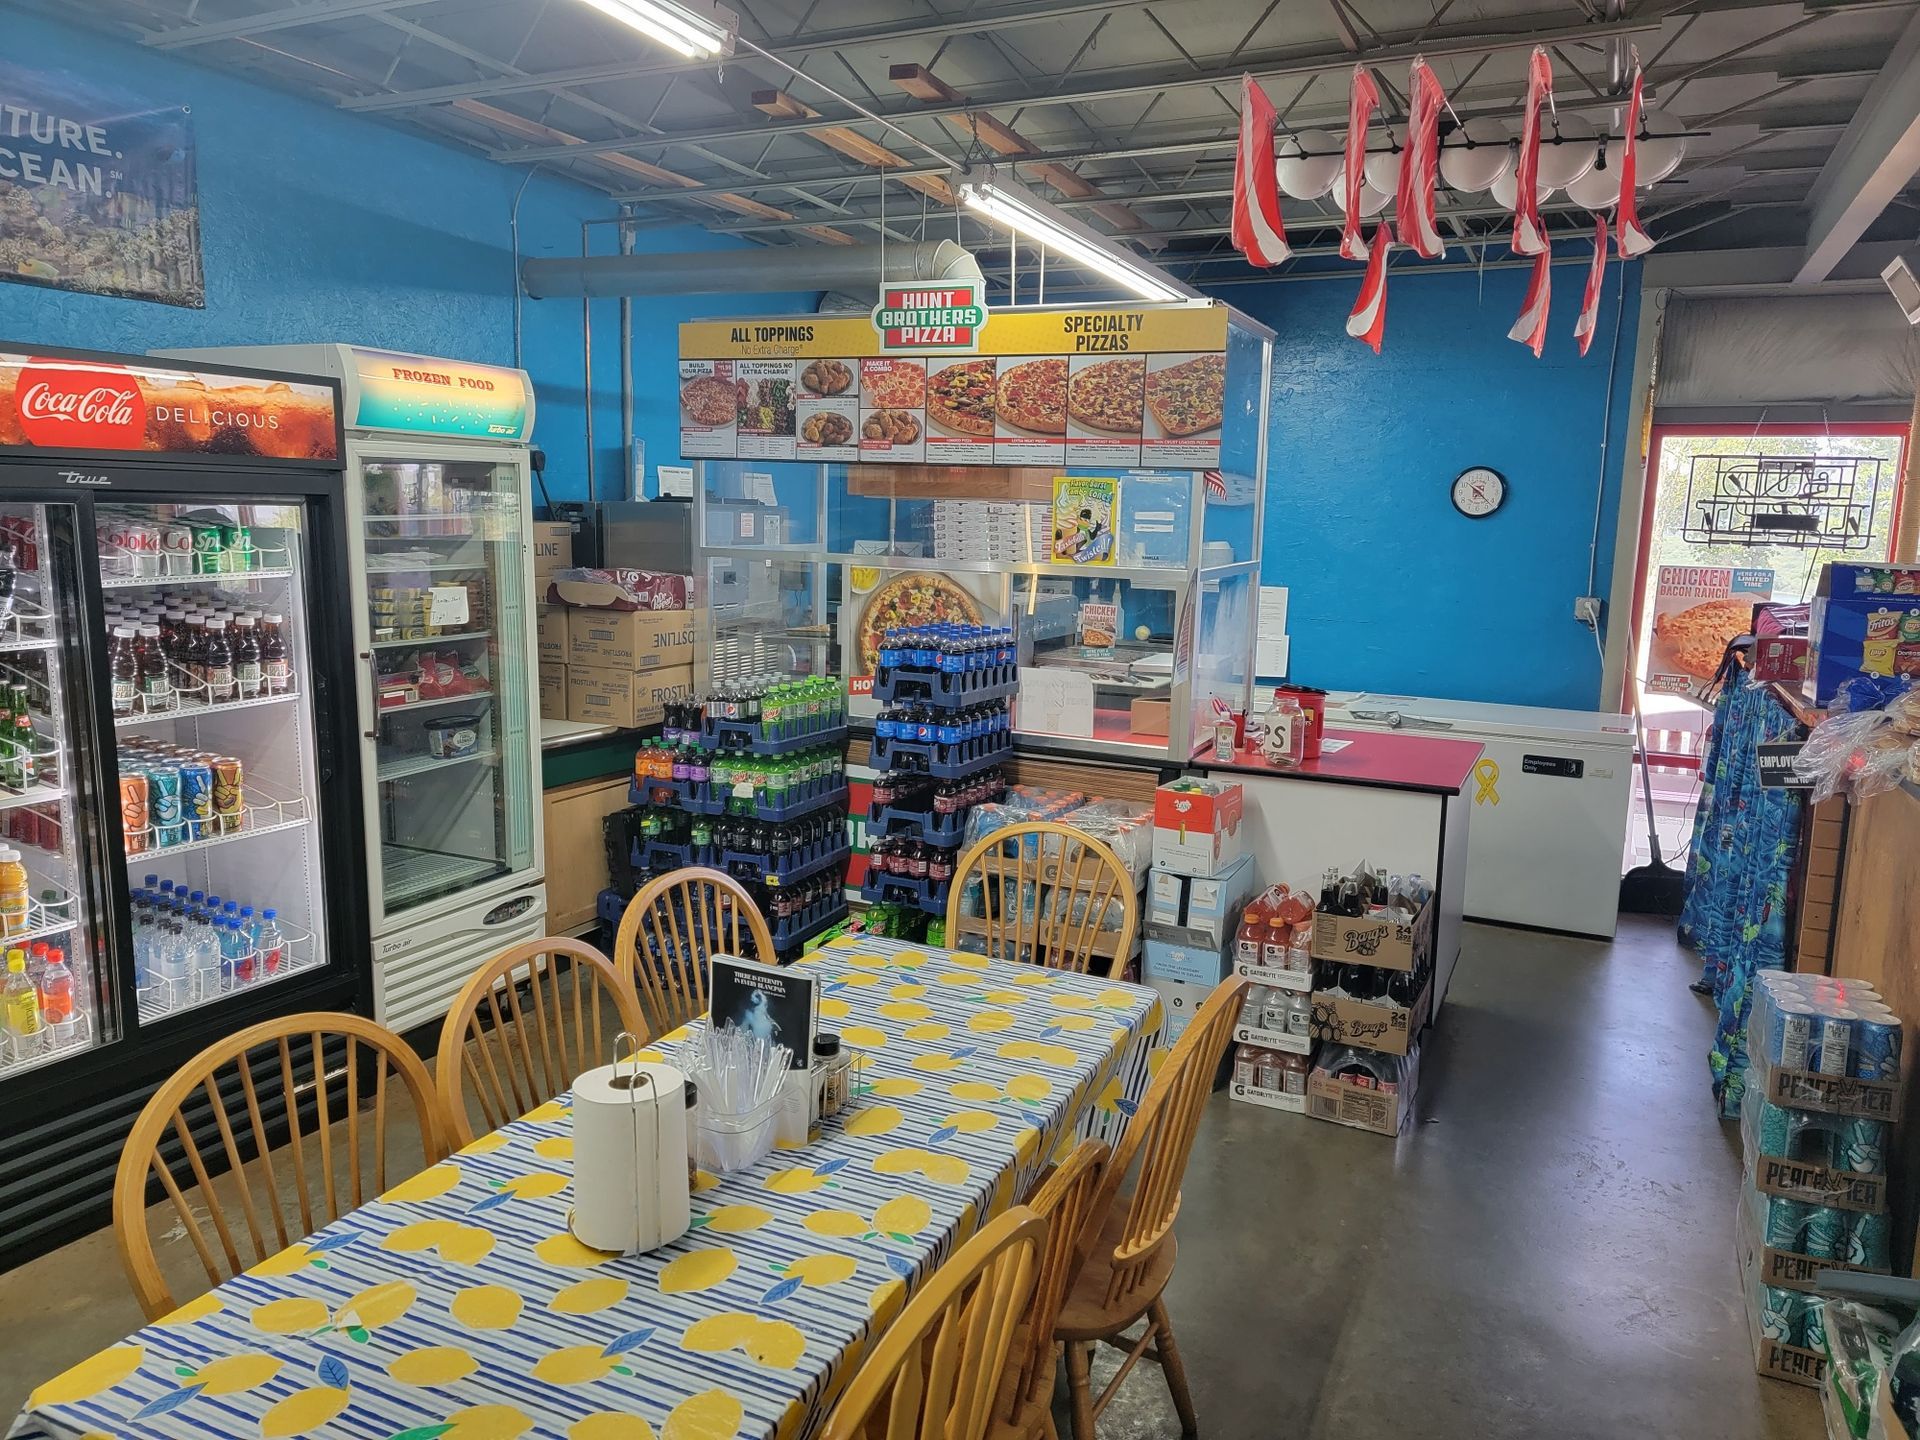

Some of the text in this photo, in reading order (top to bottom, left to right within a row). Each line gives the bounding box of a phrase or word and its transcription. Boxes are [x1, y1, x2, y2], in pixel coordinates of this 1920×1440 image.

[0, 103, 123, 159] TURE.
[902, 292, 955, 309] HUNT
[881, 309, 976, 326] BROTHERS
[1064, 314, 1143, 333] SPECIALTY
[731, 326, 813, 343] ALL TOPPINGS
[901, 327, 956, 343] PIZZA
[1076, 333, 1129, 351] PIZZAS
[741, 344, 752, 355] No
[753, 344, 772, 355] Extra
[392, 368, 495, 391] FROZEN FOOD
[22, 382, 136, 425] Coca-Cola
[156, 405, 279, 430] DELICIOUS
[1660, 567, 1731, 587] CHICKEN
[1660, 585, 1729, 599] BACON RANCH
[1084, 605, 1116, 617] CHICKEN
[1523, 764, 1538, 772] Only
[1524, 758, 1556, 767] Employees
[1783, 776, 1798, 784] THANK
[1395, 925, 1411, 935] 24
[382, 937, 412, 954] Turbo air
[1240, 942, 1249, 951] G
[1344, 925, 1389, 953] Barq's
[1266, 946, 1275, 954] G
[734, 970, 751, 980] THERE
[757, 976, 783, 987] ETERNITY
[1239, 965, 1248, 976] G
[740, 978, 757, 987] EVERY
[1390, 1011, 1407, 1021] 24
[1238, 1029, 1249, 1041] G
[1350, 1021, 1388, 1038] Barq's
[1234, 1084, 1245, 1096] G
[1766, 1161, 1825, 1190] PEACE
